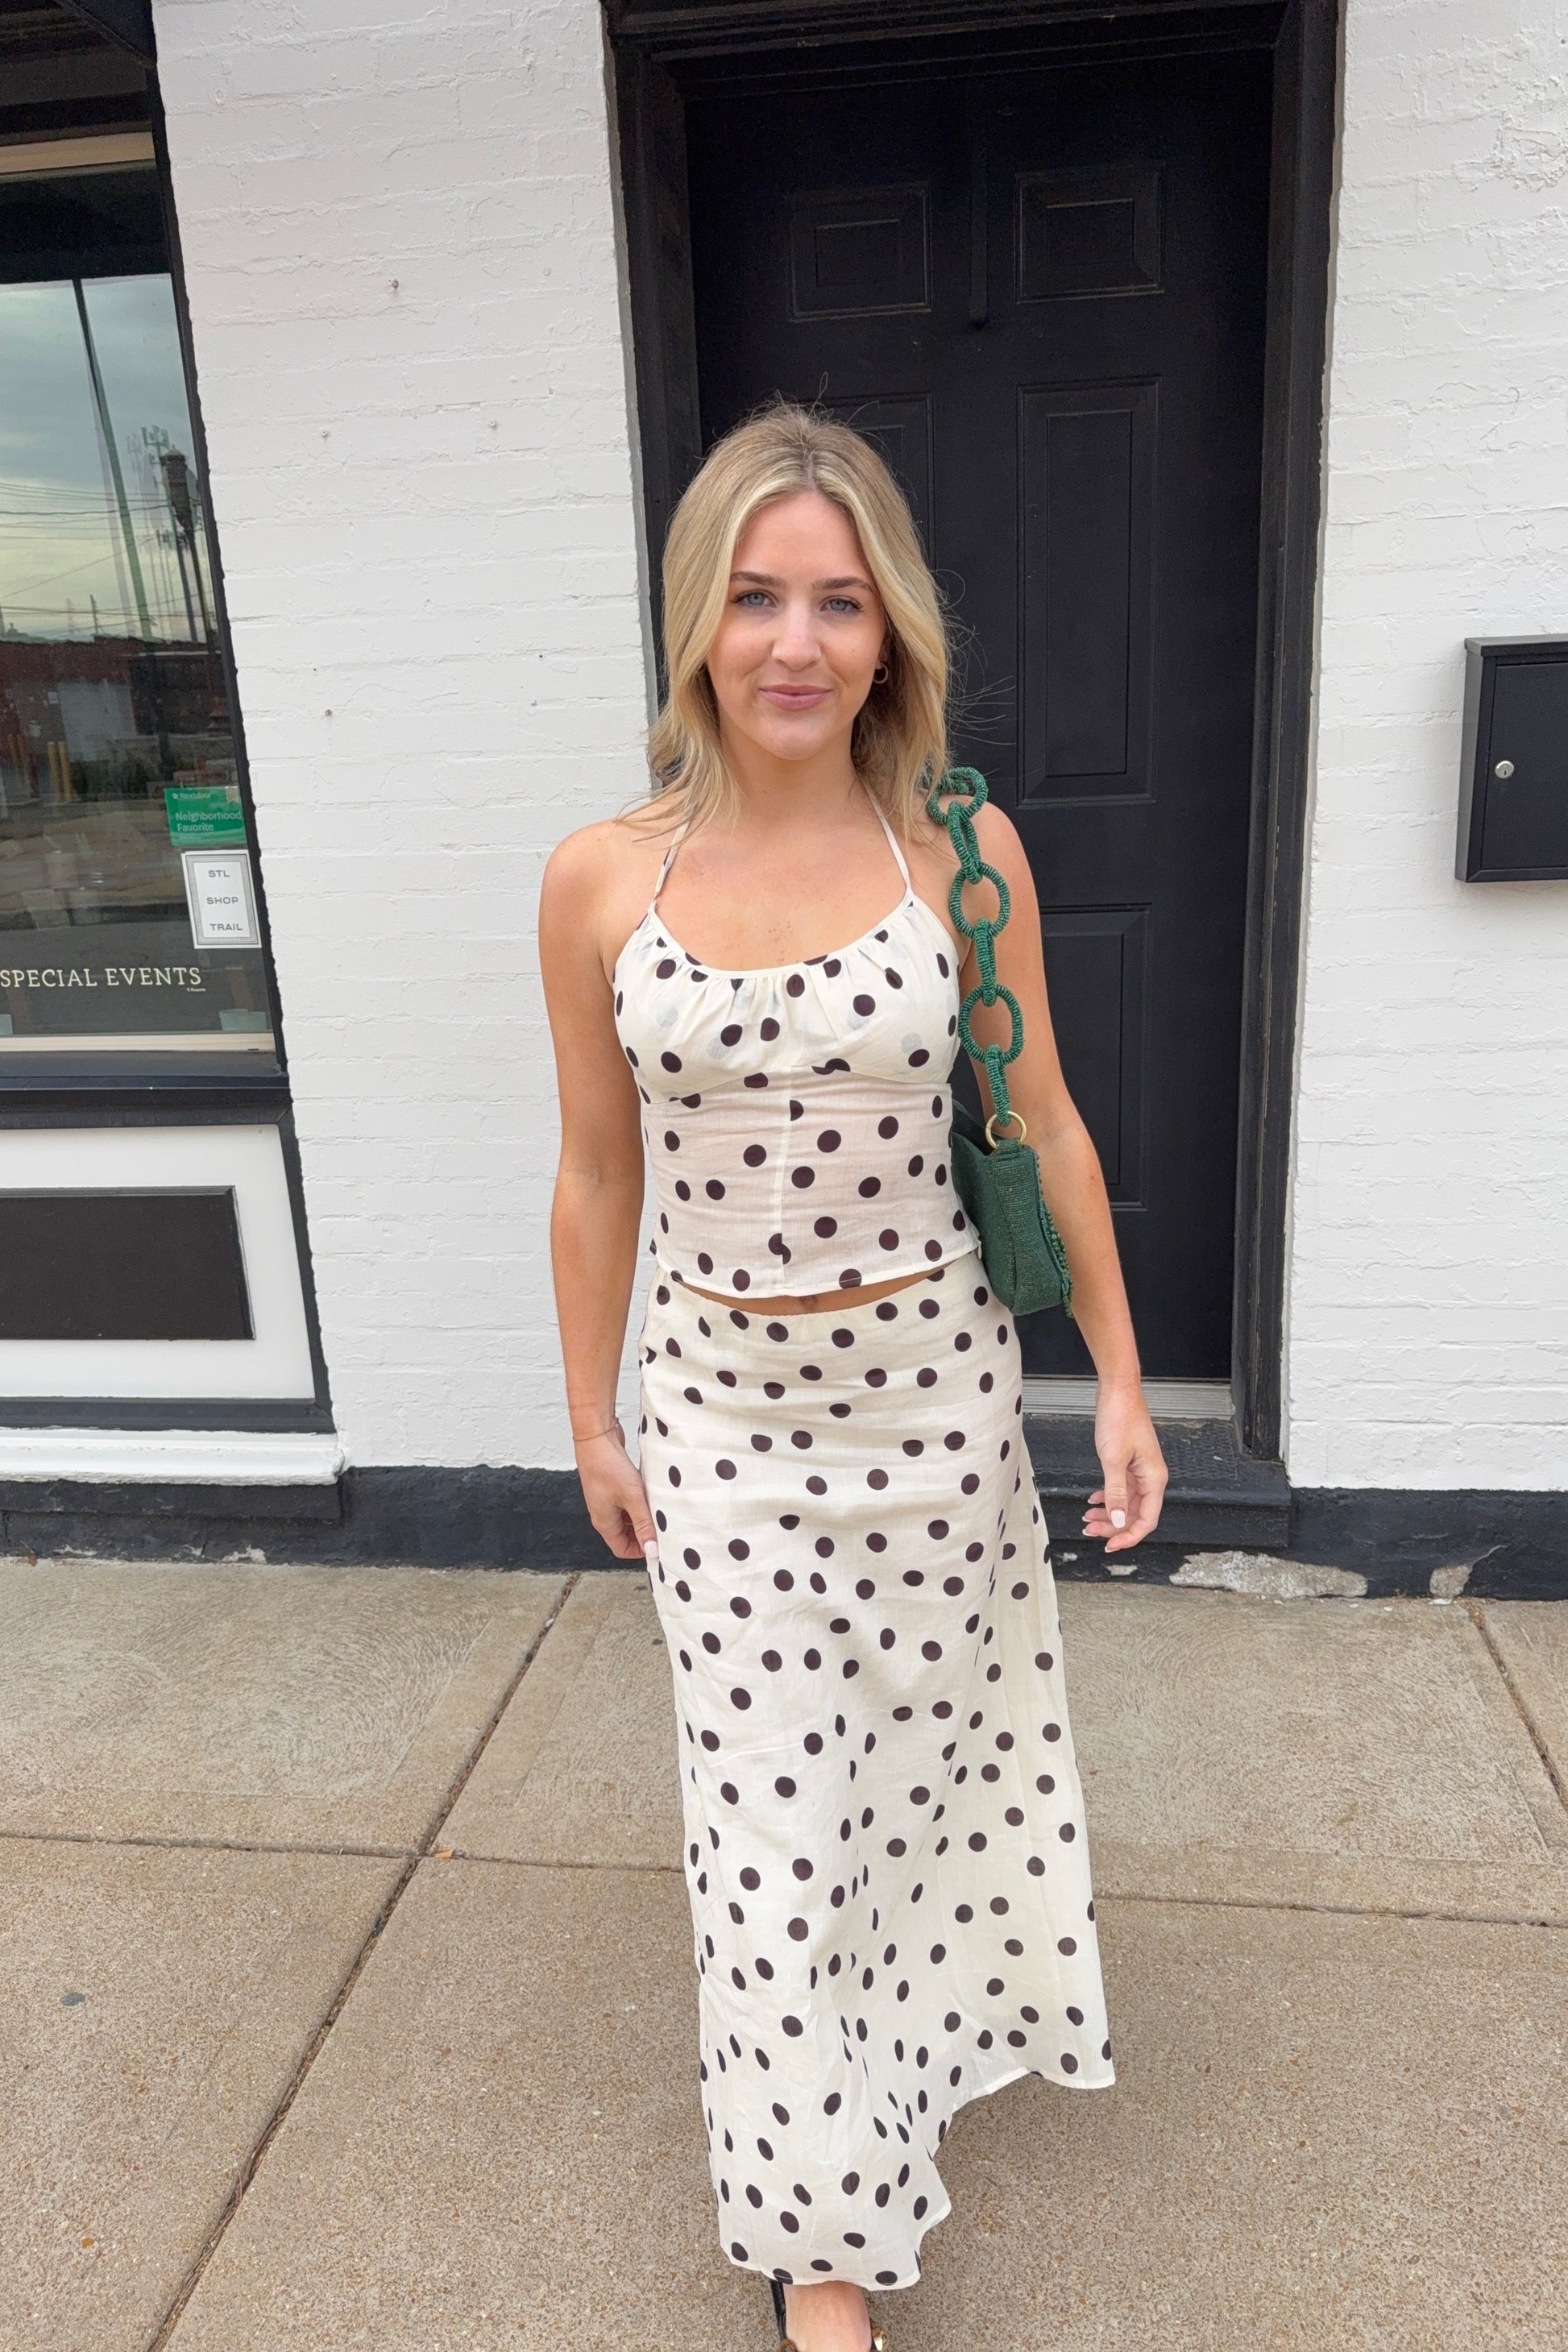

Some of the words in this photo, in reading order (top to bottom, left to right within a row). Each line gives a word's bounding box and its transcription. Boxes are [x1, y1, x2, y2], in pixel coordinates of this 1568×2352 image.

[180, 792, 211, 800] Nextdoor
[175, 811, 242, 821] Neighborhood
[176, 823, 214, 832] Favorite
[208, 869, 230, 877] STL
[206, 896, 239, 905] SHOP
[209, 923, 243, 931] TRAIL
[0, 969, 97, 988] SPECIAL
[105, 967, 202, 986] EVENTS
